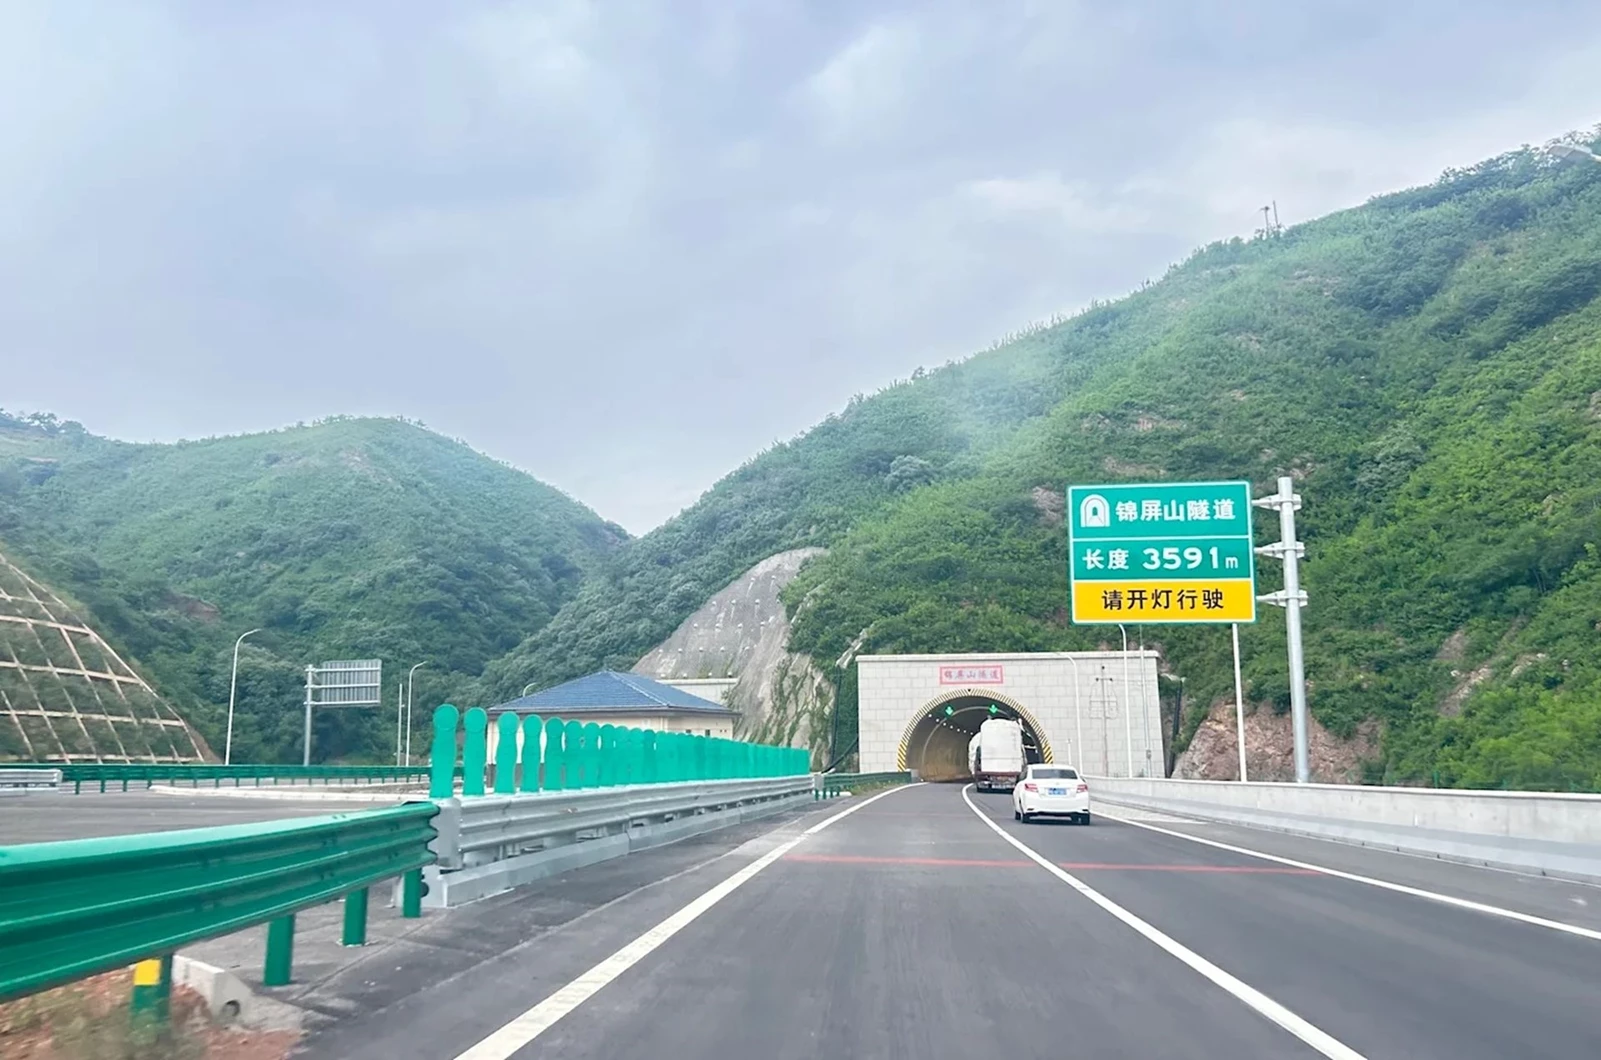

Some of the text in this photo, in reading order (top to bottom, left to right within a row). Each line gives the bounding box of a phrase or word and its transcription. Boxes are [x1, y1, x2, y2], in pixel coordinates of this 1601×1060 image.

[1115, 499, 1236, 522] 锦屏山隧道
[1082, 548, 1129, 570] 长度
[1101, 588, 1224, 611] 请开灯行驶
